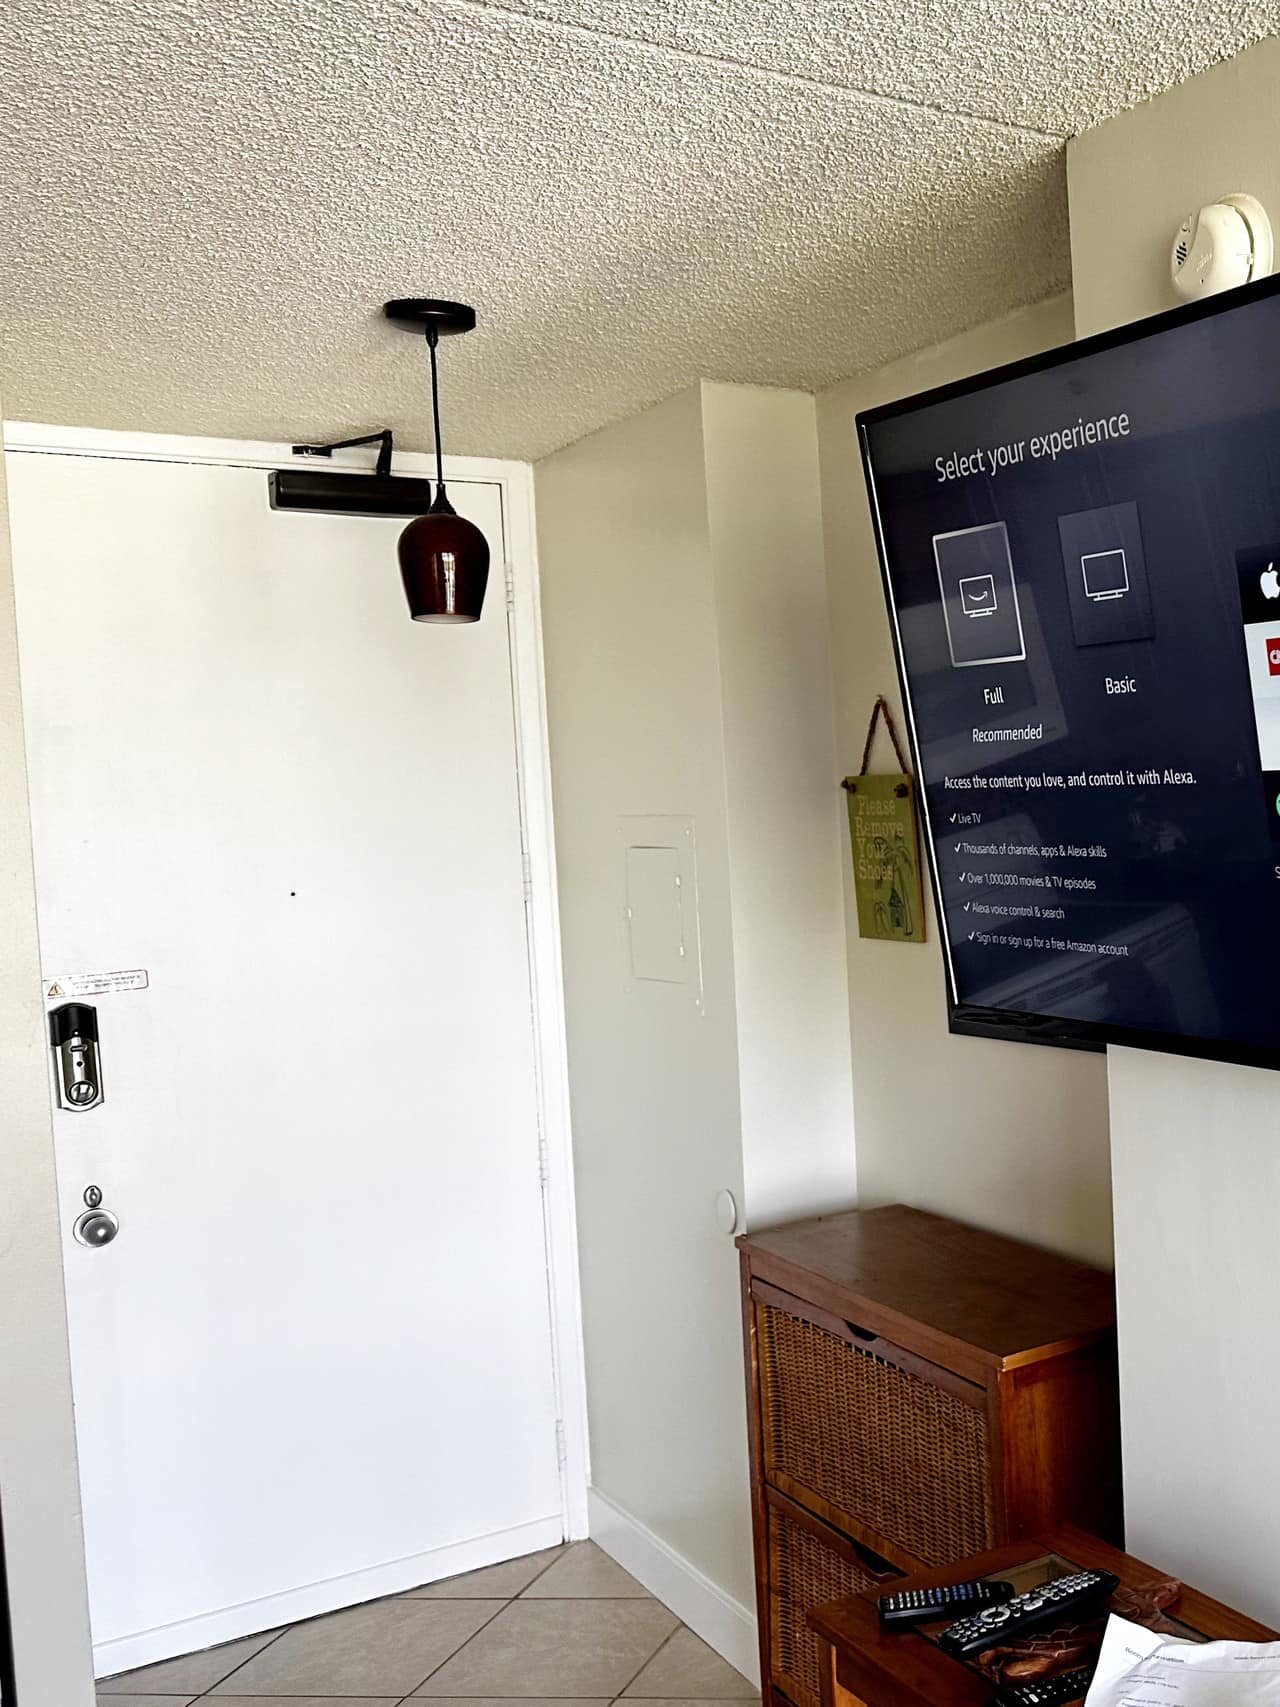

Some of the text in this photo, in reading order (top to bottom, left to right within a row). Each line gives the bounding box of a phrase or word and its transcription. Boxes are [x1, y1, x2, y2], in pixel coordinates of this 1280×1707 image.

[935, 412, 1130, 483] Select your experience
[1105, 675, 1137, 695] Basic
[984, 687, 1004, 704] Full
[972, 724, 1043, 743] Recommended
[944, 768, 1197, 791] Access the content you love, and control it with Alexa.
[858, 794, 896, 817] Please
[855, 816, 904, 838] Remove
[957, 813, 982, 824] Live TV
[962, 842, 1107, 858] Thousands of channels, apps & Alexa skills
[967, 873, 1097, 891] Over 1,000,000 movies & TV episodes
[972, 902, 1065, 919] Alexa voice control & search
[976, 932, 992, 945] Sign
[999, 935, 1008, 945] or
[1008, 936, 1023, 948] sign
[1023, 937, 1033, 949] up
[1033, 937, 1045, 948] for
[1051, 937, 1066, 950] free
[1066, 940, 1097, 954] Amazon
[1098, 943, 1129, 957] account
